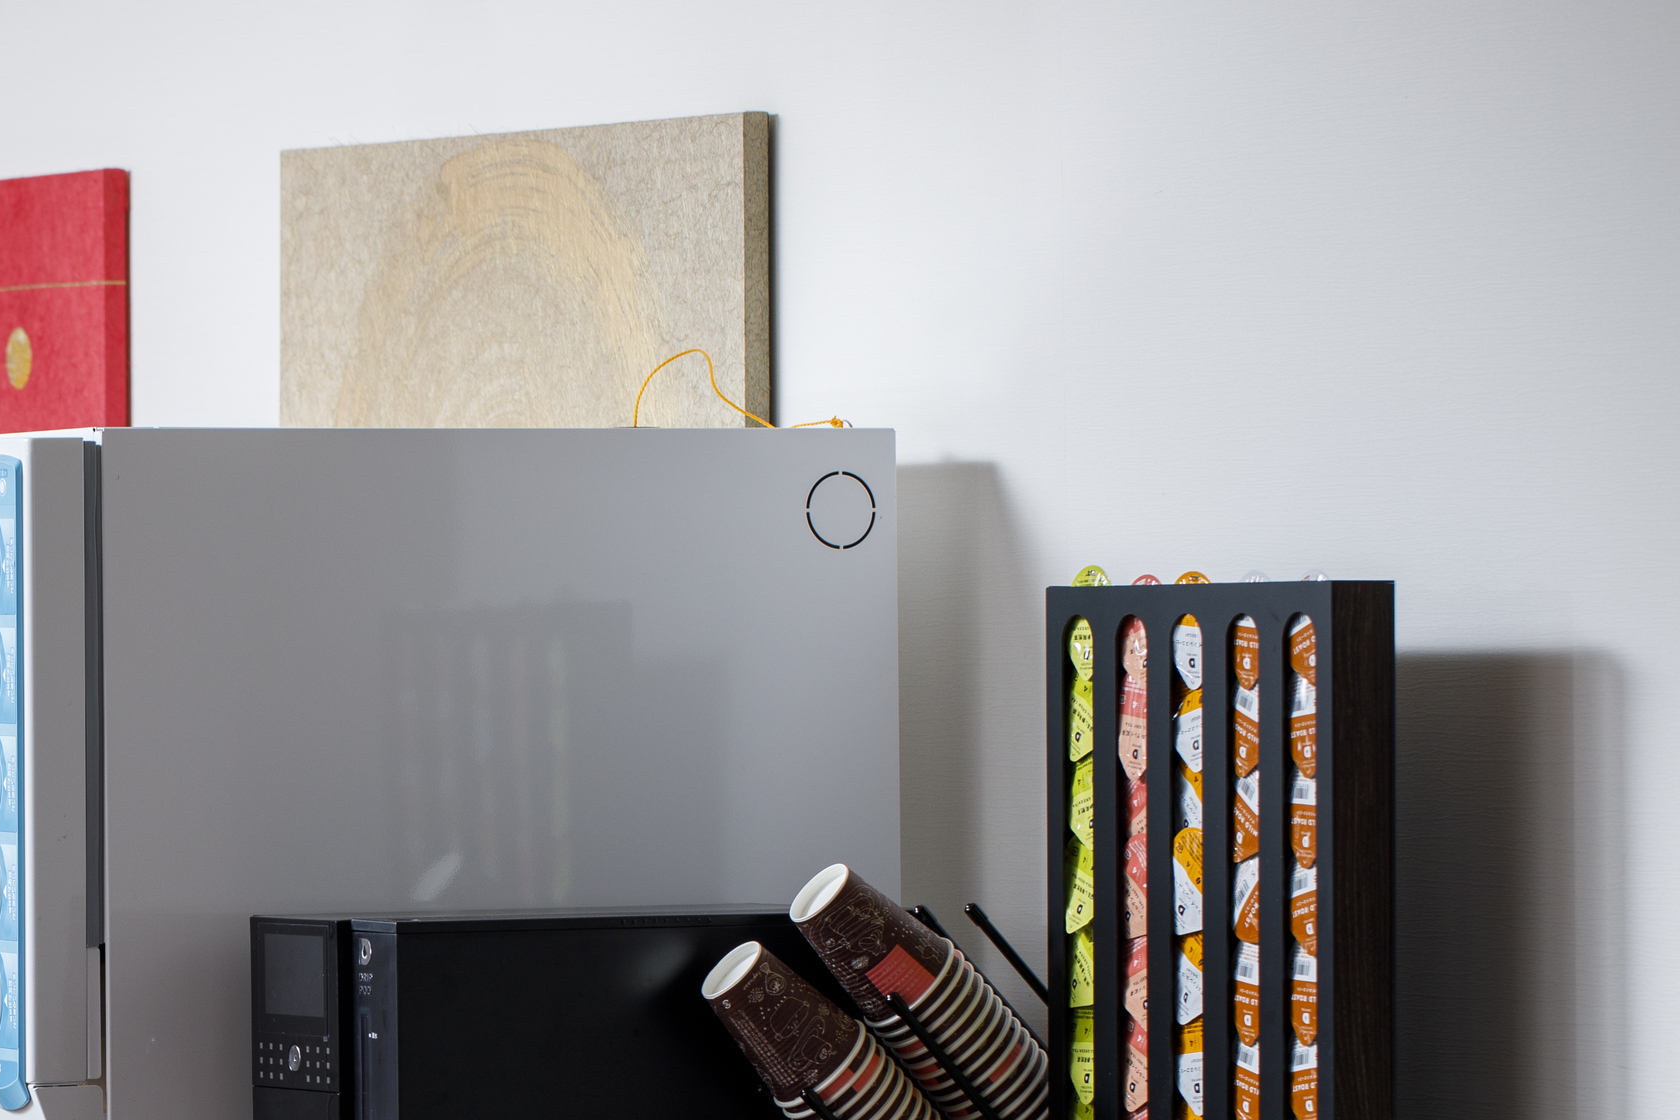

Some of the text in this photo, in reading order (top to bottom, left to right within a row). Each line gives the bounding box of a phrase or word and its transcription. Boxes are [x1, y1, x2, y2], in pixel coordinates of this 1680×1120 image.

[1293, 640, 1310, 655] ROAST
[1290, 729, 1307, 738] ROAST
[1291, 817, 1307, 826] ROAST
[1292, 907, 1309, 918] ROAST
[359, 973, 374, 982] DRIP
[359, 986, 372, 995] POD
[1234, 994, 1249, 1004] ROAST
[1291, 994, 1307, 1002] ROAST
[1292, 1083, 1309, 1092] ROAST
